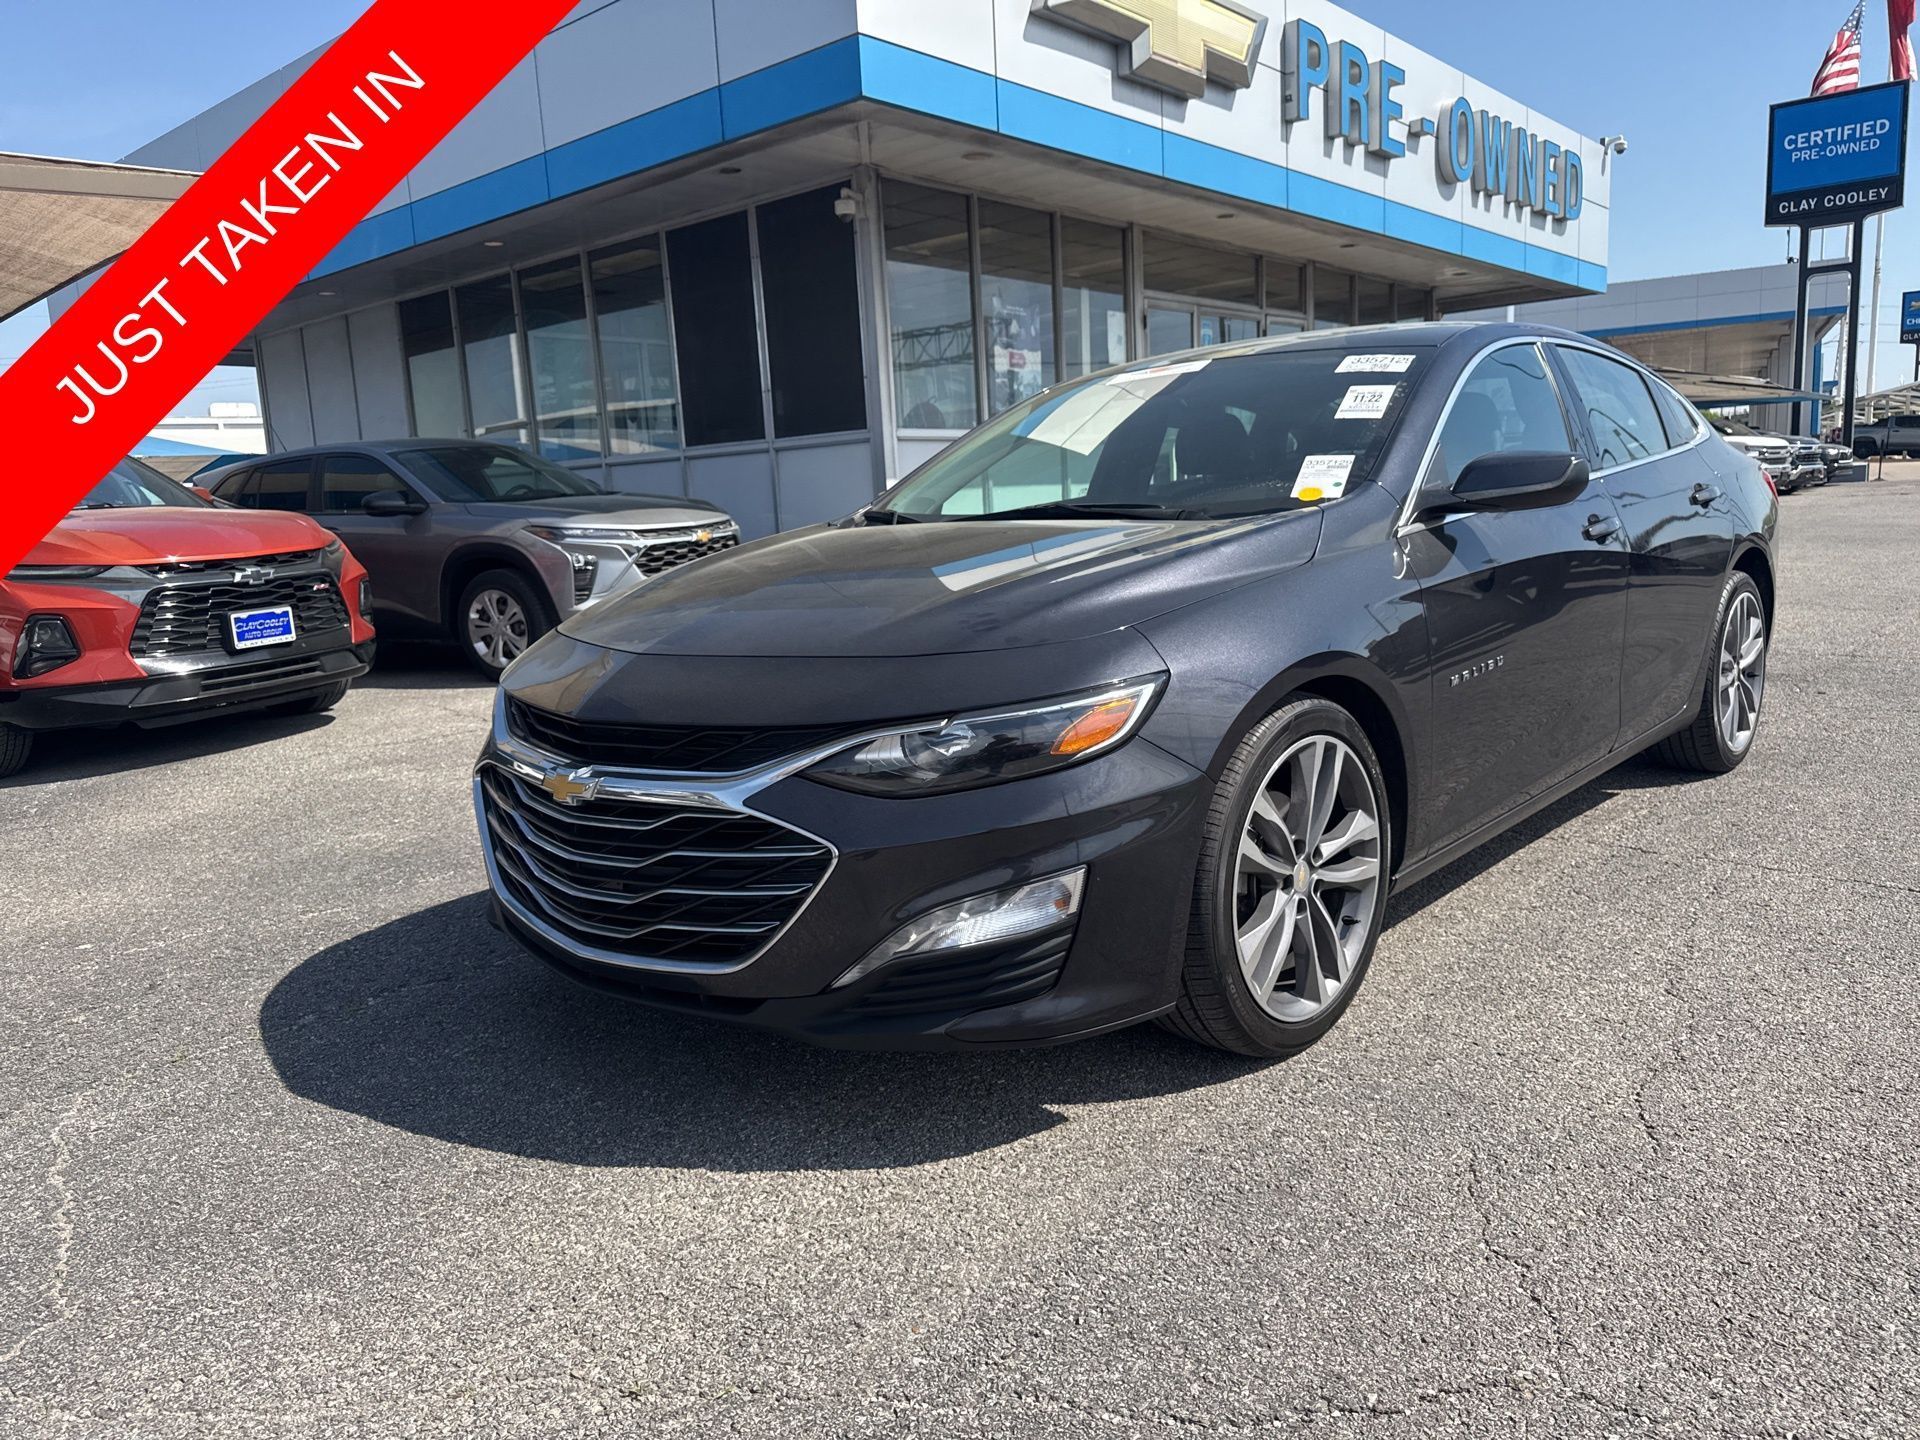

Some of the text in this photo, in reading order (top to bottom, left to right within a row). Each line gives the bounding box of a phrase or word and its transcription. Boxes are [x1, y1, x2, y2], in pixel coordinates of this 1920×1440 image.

[1286, 18, 1583, 221] PRE-OWNED
[1783, 118, 1890, 150] CERTIFIED
[1791, 138, 1880, 163] PRE-OWNED
[1778, 187, 1889, 214] CLAY COOLEY
[1353, 394, 1383, 403] 11:22
[244, 630, 261, 639] AUTO
[1451, 655, 1504, 687] MALIBU
